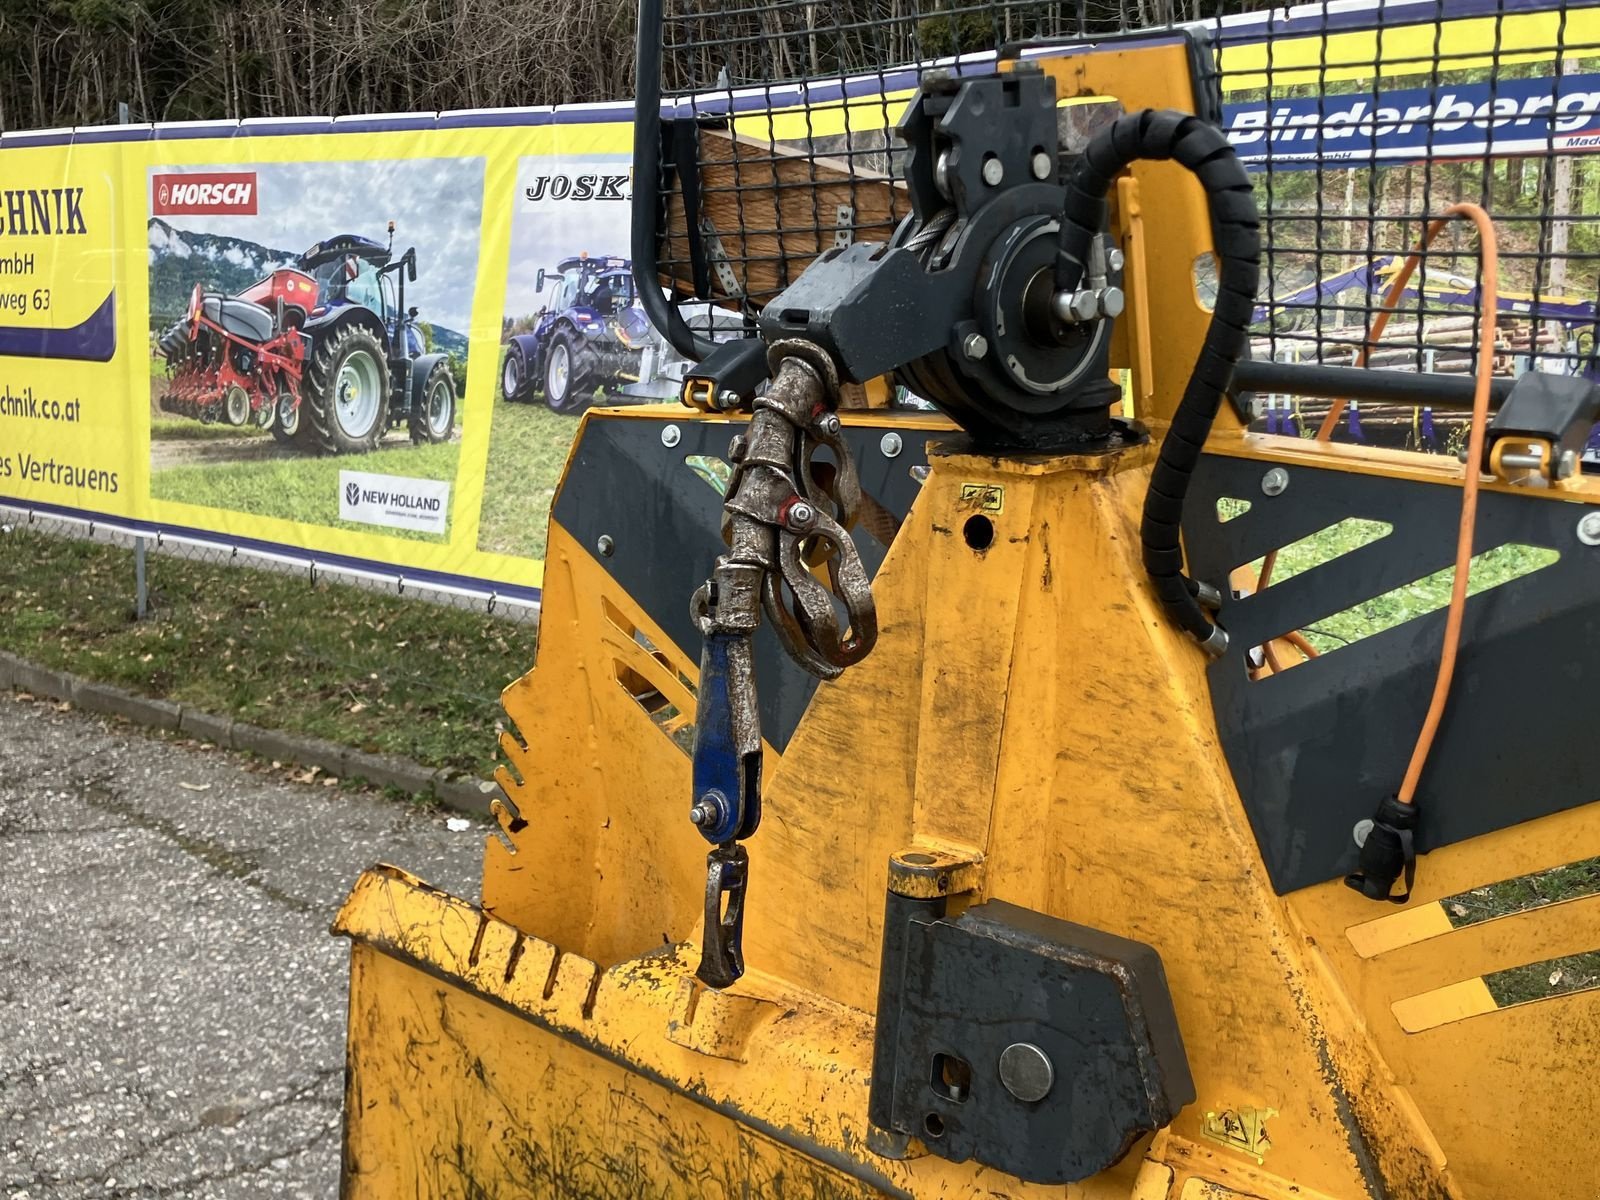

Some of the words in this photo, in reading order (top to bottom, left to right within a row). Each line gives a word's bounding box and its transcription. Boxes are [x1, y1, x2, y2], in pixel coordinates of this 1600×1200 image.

[1224, 92, 1600, 144] Binderberg
[170, 183, 252, 206] HORSCH
[526, 175, 633, 201] JOSK
[0, 188, 87, 235] HNIK
[33, 289, 50, 310] 63
[0, 384, 80, 422] chnik.co.at
[18, 453, 118, 493] Vertrauens
[362, 490, 389, 505] NEW
[390, 494, 440, 511] HOLLAND
